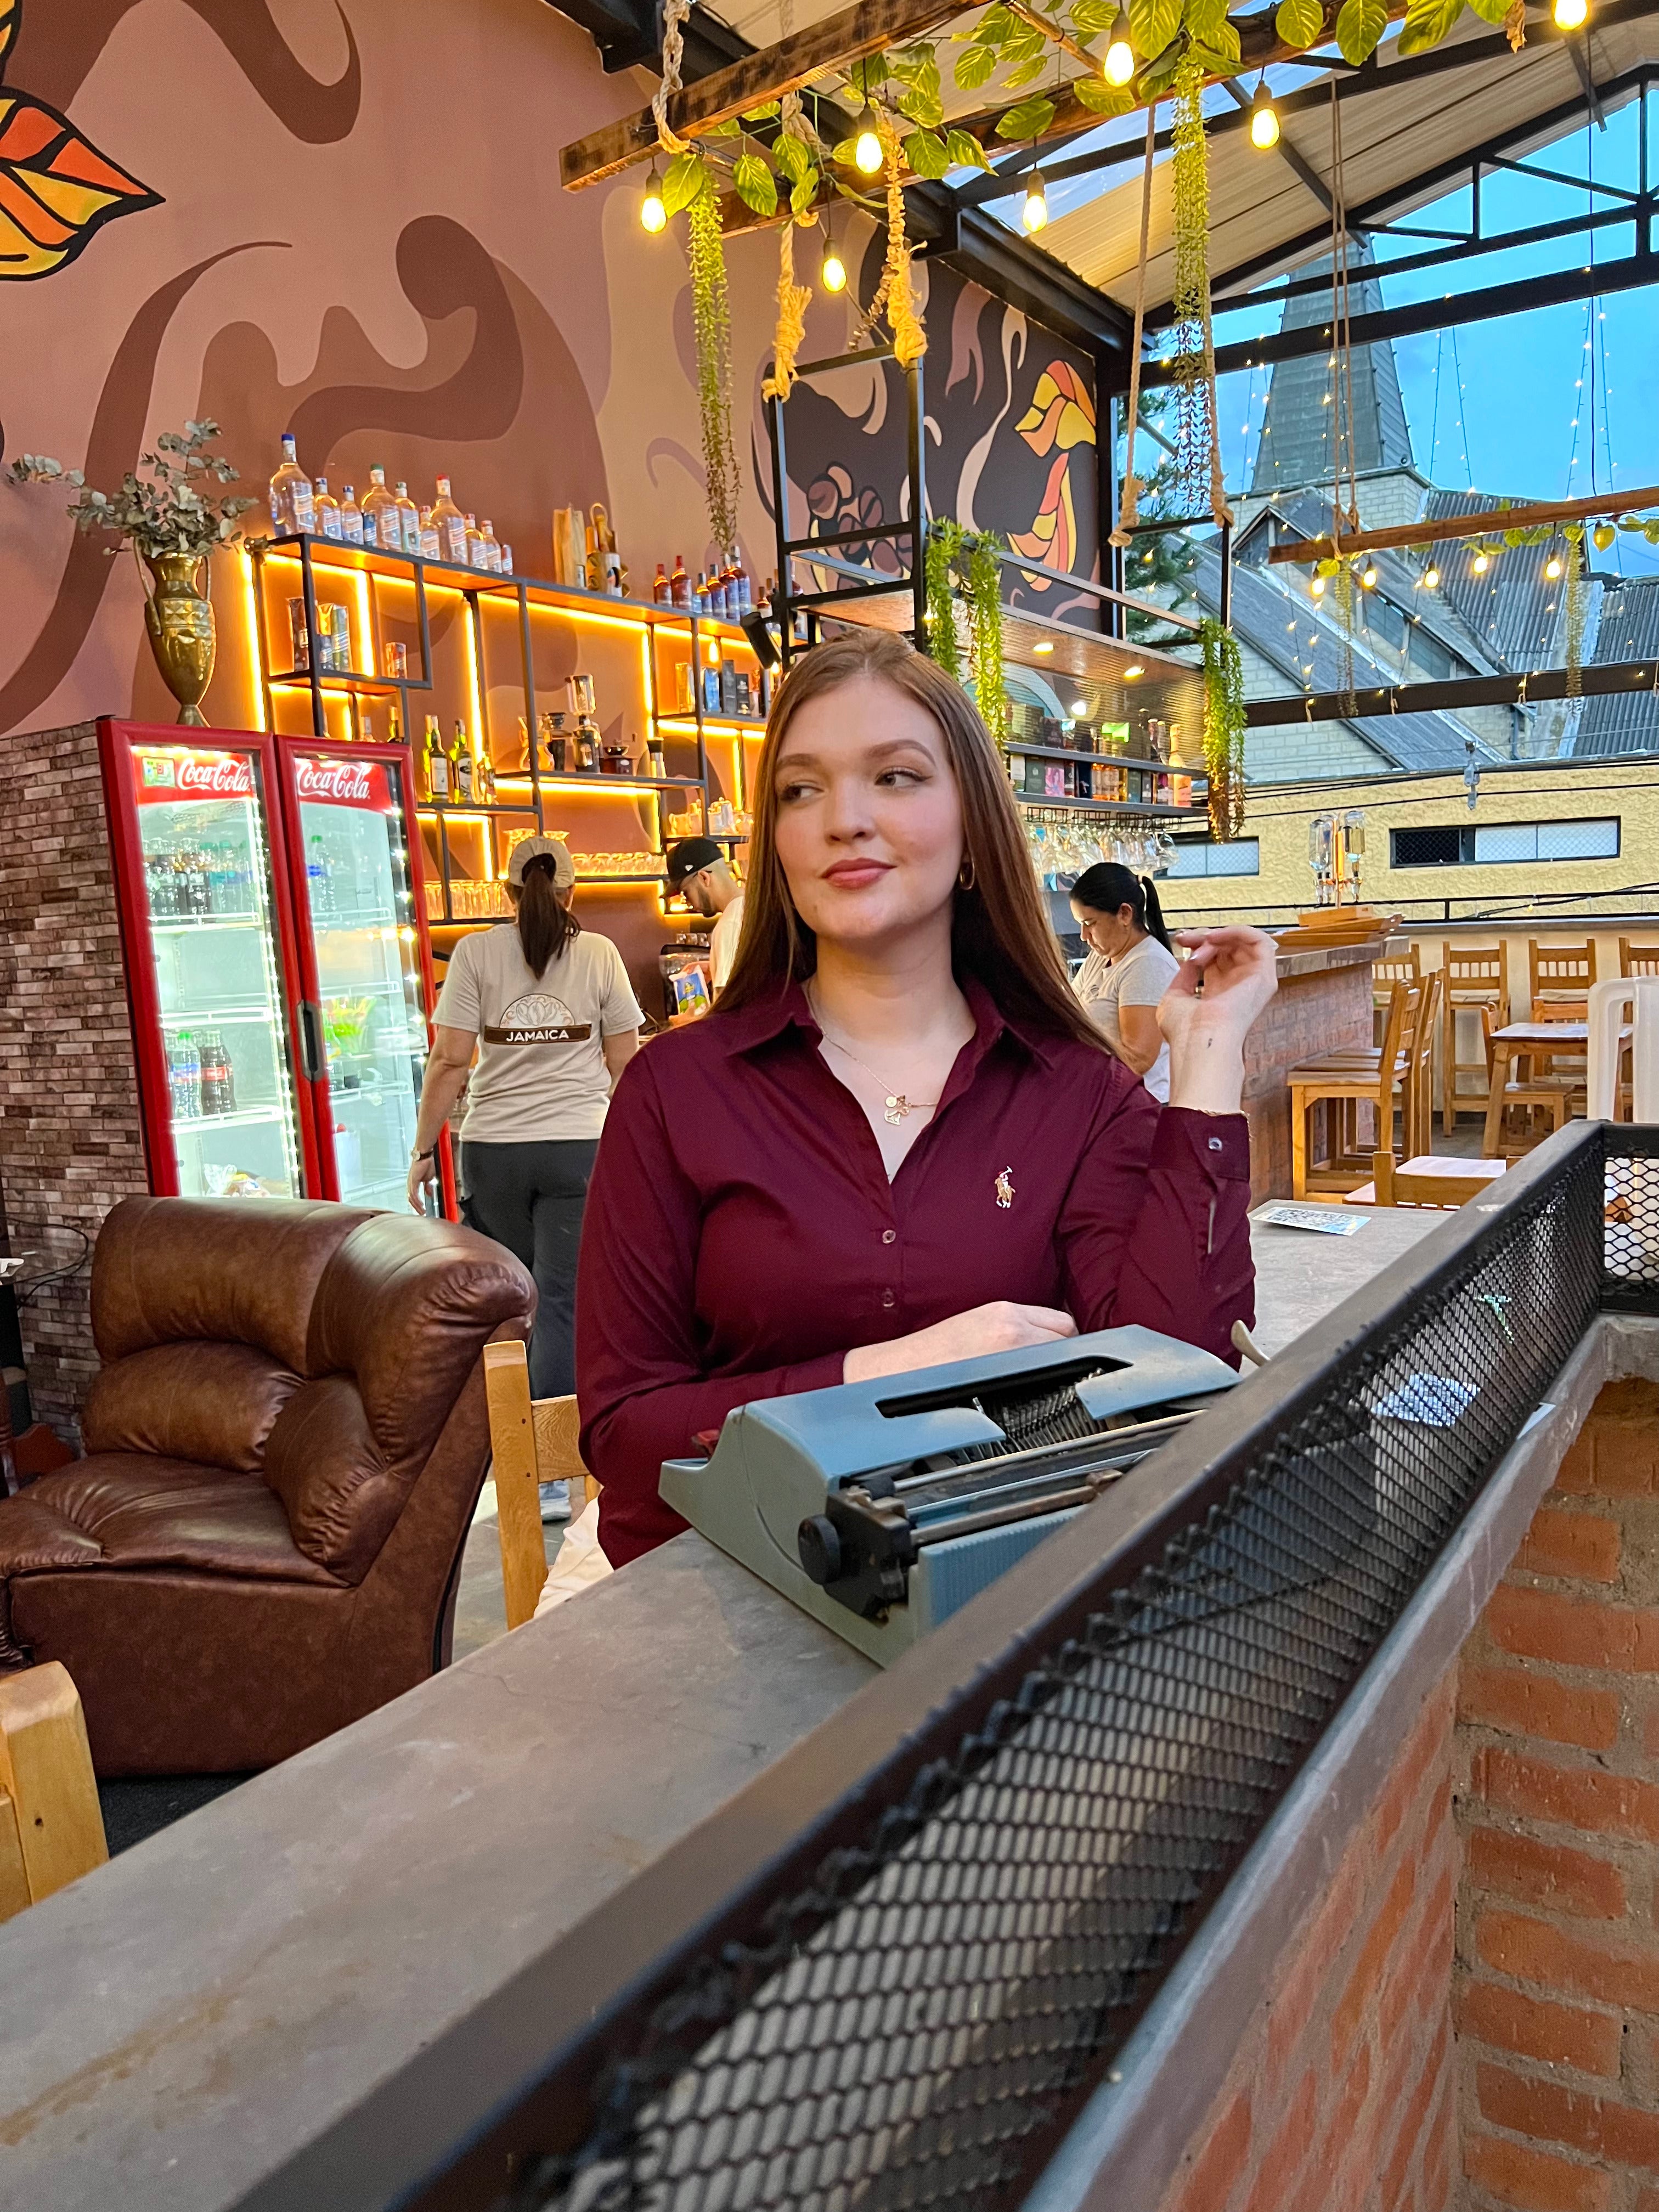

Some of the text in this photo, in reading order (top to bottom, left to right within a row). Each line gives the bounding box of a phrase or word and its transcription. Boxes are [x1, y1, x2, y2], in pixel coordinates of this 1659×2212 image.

[177, 758, 250, 792] Coca-Cola
[296, 761, 371, 799] Coca-Cola
[506, 1030, 569, 1042] JAMAICA
